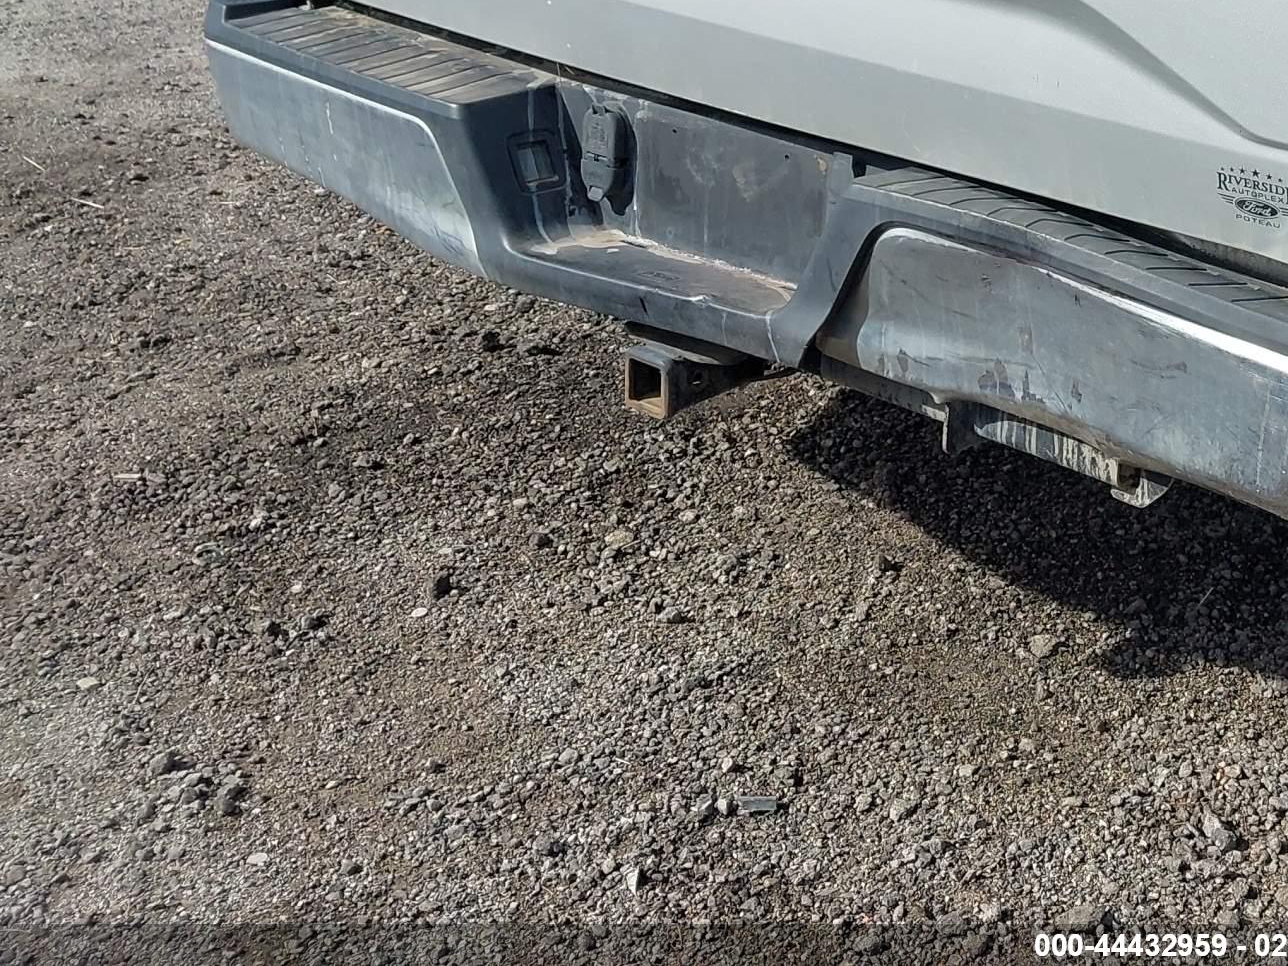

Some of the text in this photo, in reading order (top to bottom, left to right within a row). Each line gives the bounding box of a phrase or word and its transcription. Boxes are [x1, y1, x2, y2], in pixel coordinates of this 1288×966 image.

[1231, 187, 1285, 204] AUTOPLEX
[1242, 201, 1272, 217] Ford
[1235, 214, 1281, 229] POTEAU
